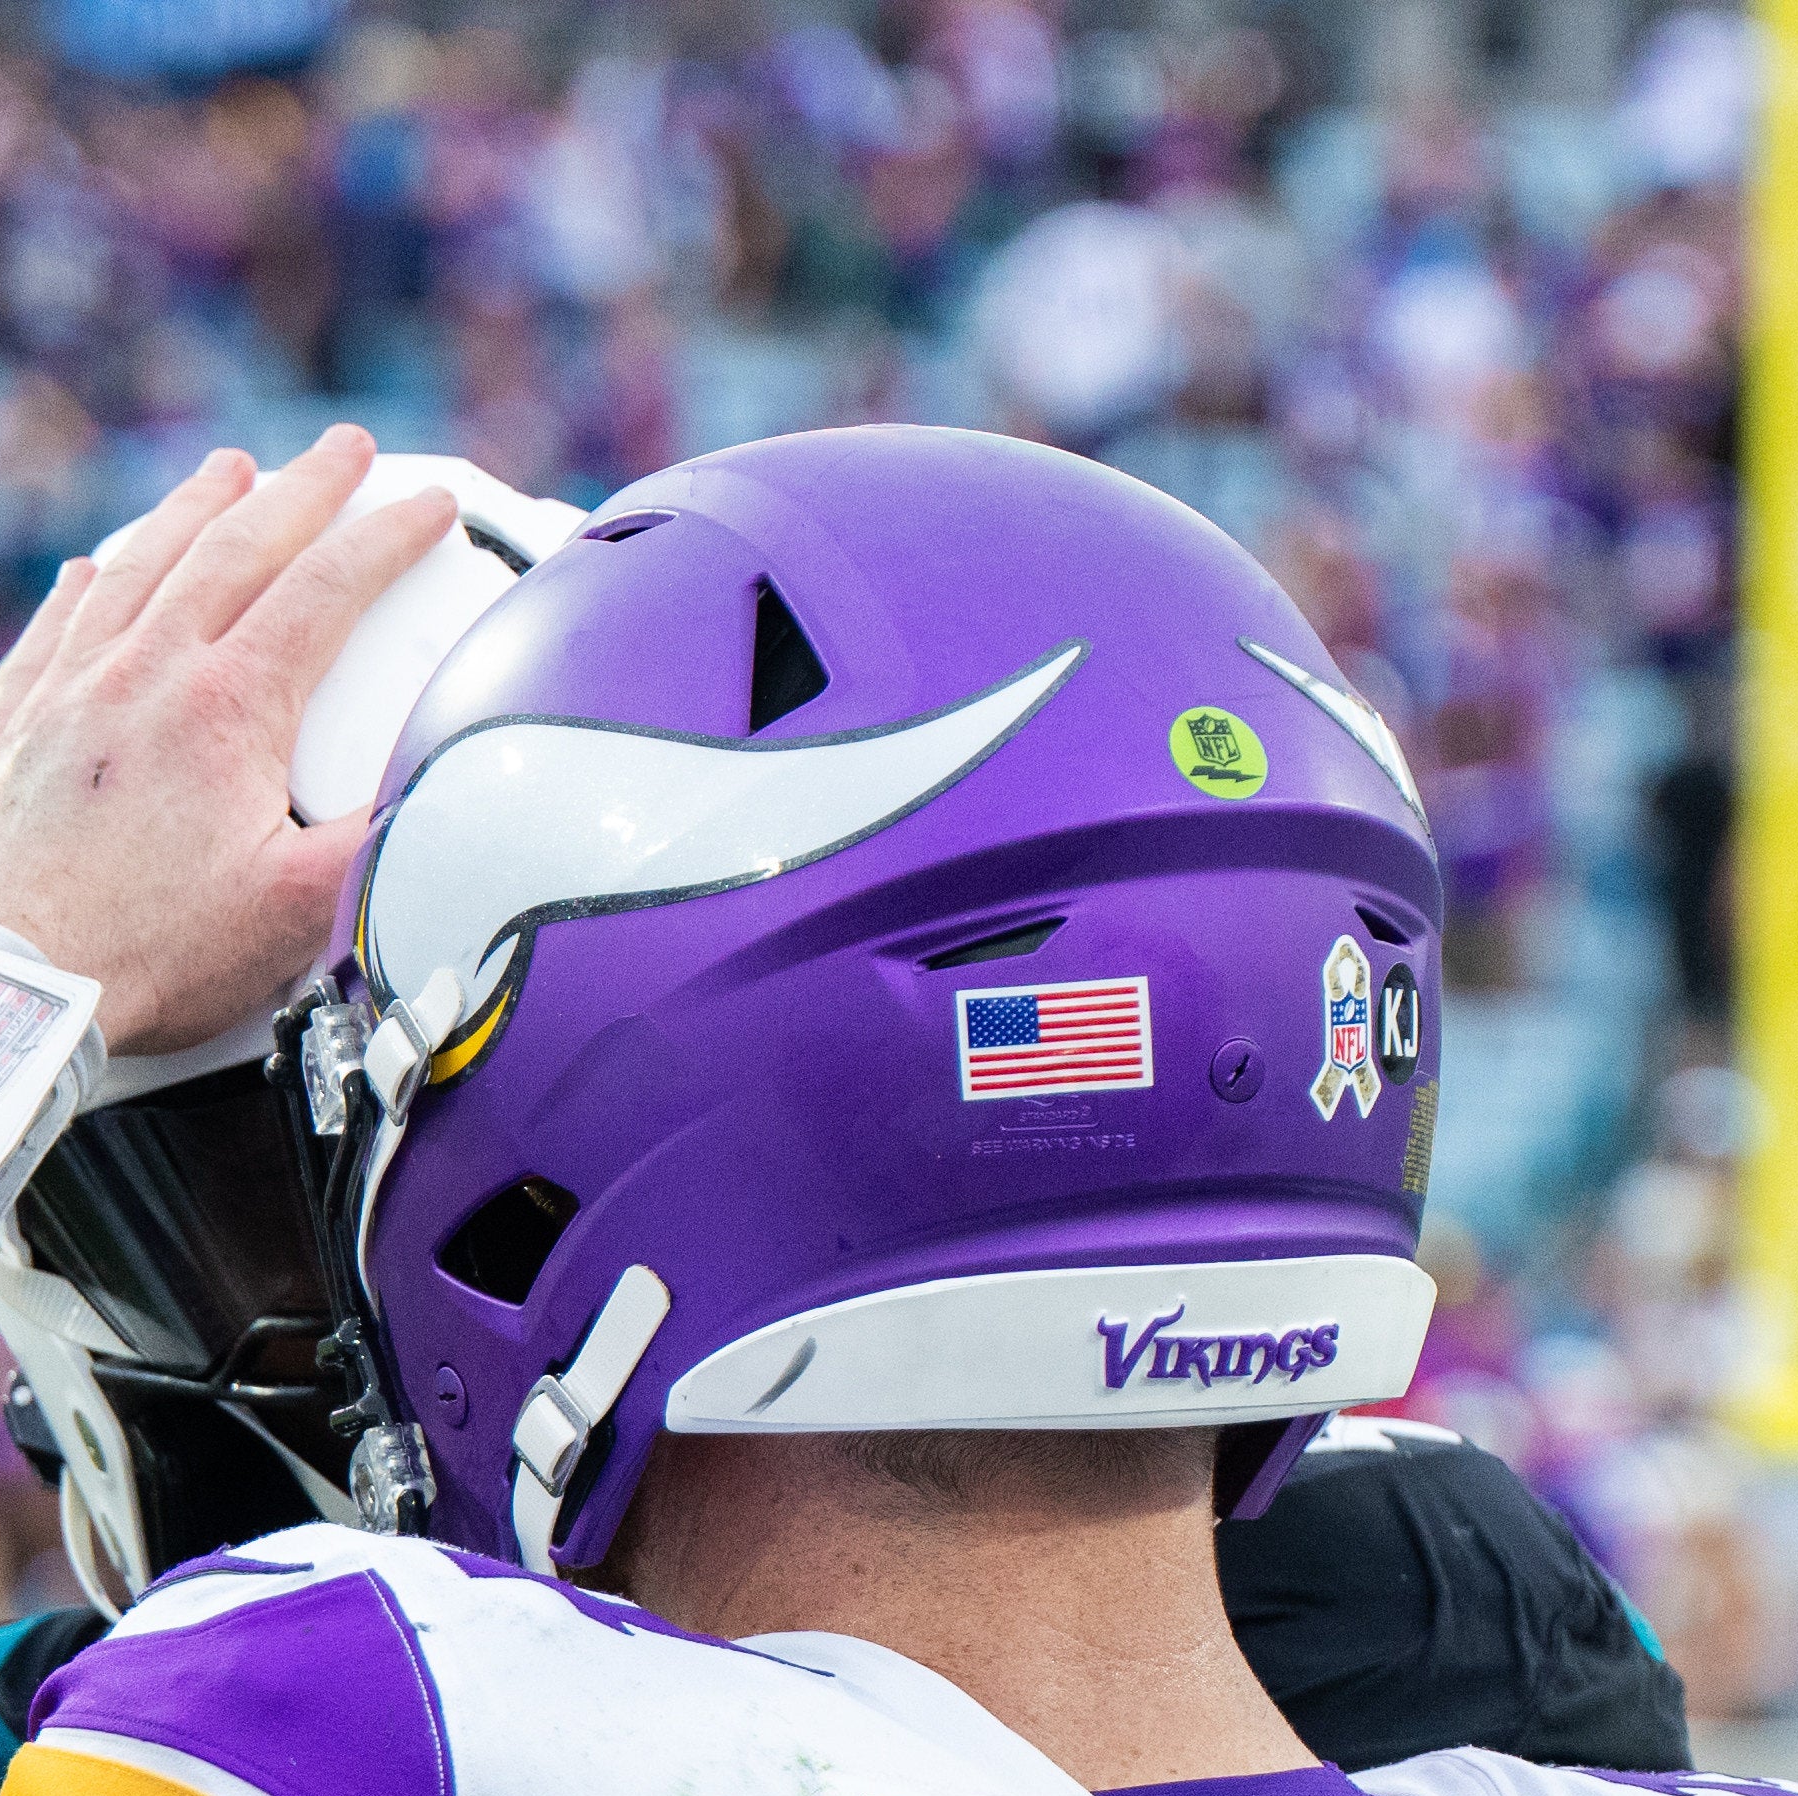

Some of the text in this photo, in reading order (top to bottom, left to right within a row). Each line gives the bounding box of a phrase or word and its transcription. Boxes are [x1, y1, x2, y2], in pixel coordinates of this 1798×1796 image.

[1197, 736, 1237, 760] NFL
[1383, 987, 1418, 1058] KJ
[1334, 1026, 1364, 1065] NFL
